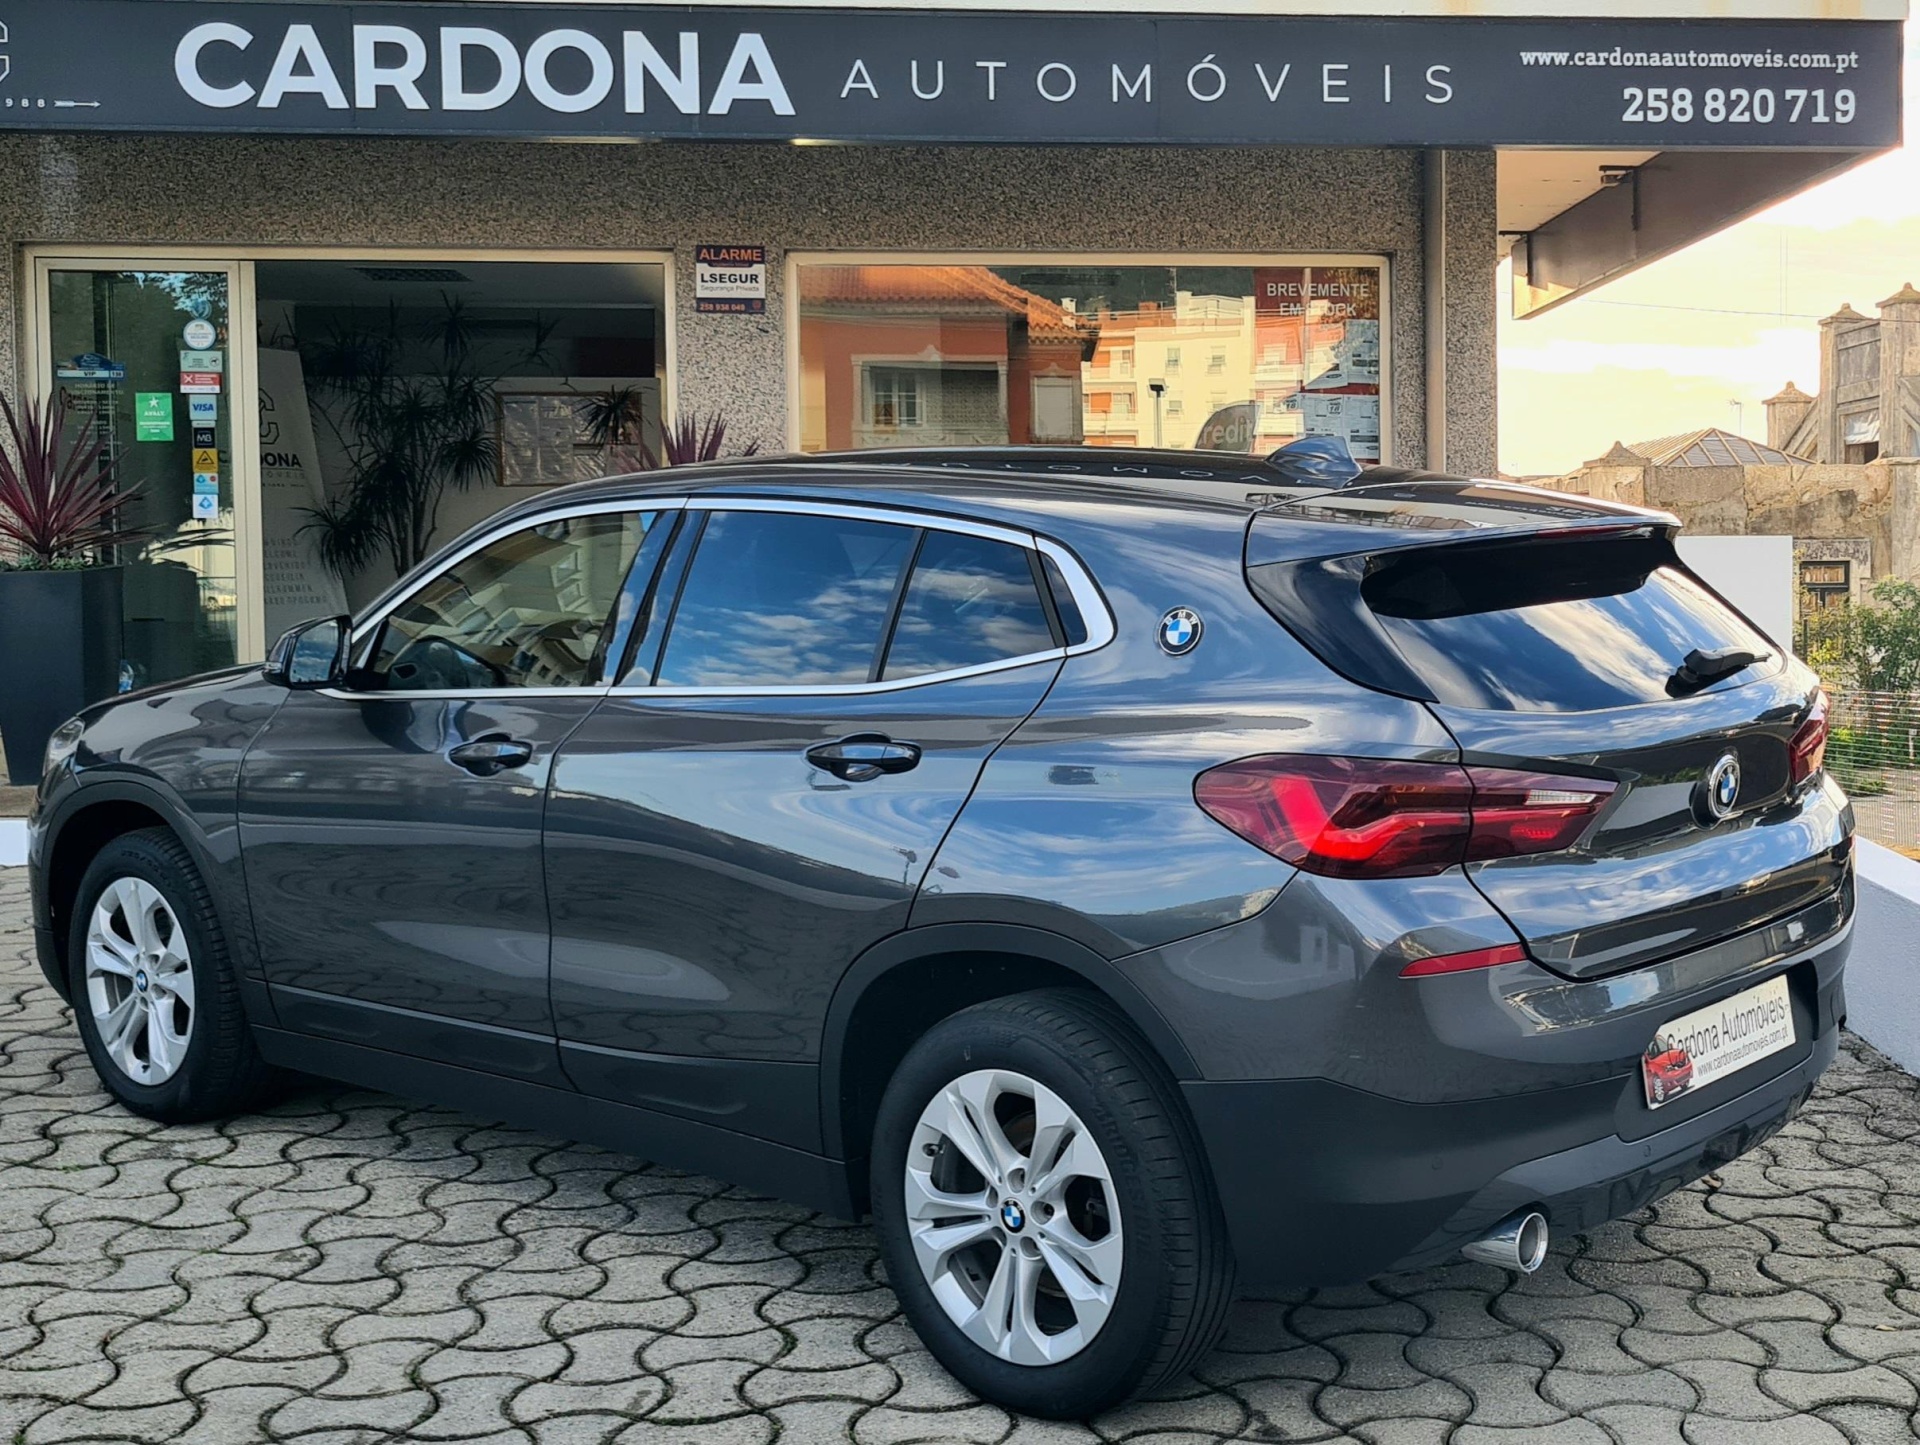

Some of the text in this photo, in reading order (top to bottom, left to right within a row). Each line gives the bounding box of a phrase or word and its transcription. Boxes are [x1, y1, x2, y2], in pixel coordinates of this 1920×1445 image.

[173, 22, 797, 117] CARDONA
[1519, 47, 1859, 73] www.cardonaautomoveis.com.pt
[840, 54, 1454, 104] AUTOMÓVEIS
[1621, 87, 1856, 123] 258 820 719
[699, 247, 763, 262] ALARME
[700, 273, 760, 284] LSEGUR
[1266, 282, 1370, 297] BREVEMENTE
[1280, 302, 1301, 316] EM
[192, 403, 214, 412] VISA
[1666, 1024, 1720, 1067] Cardona
